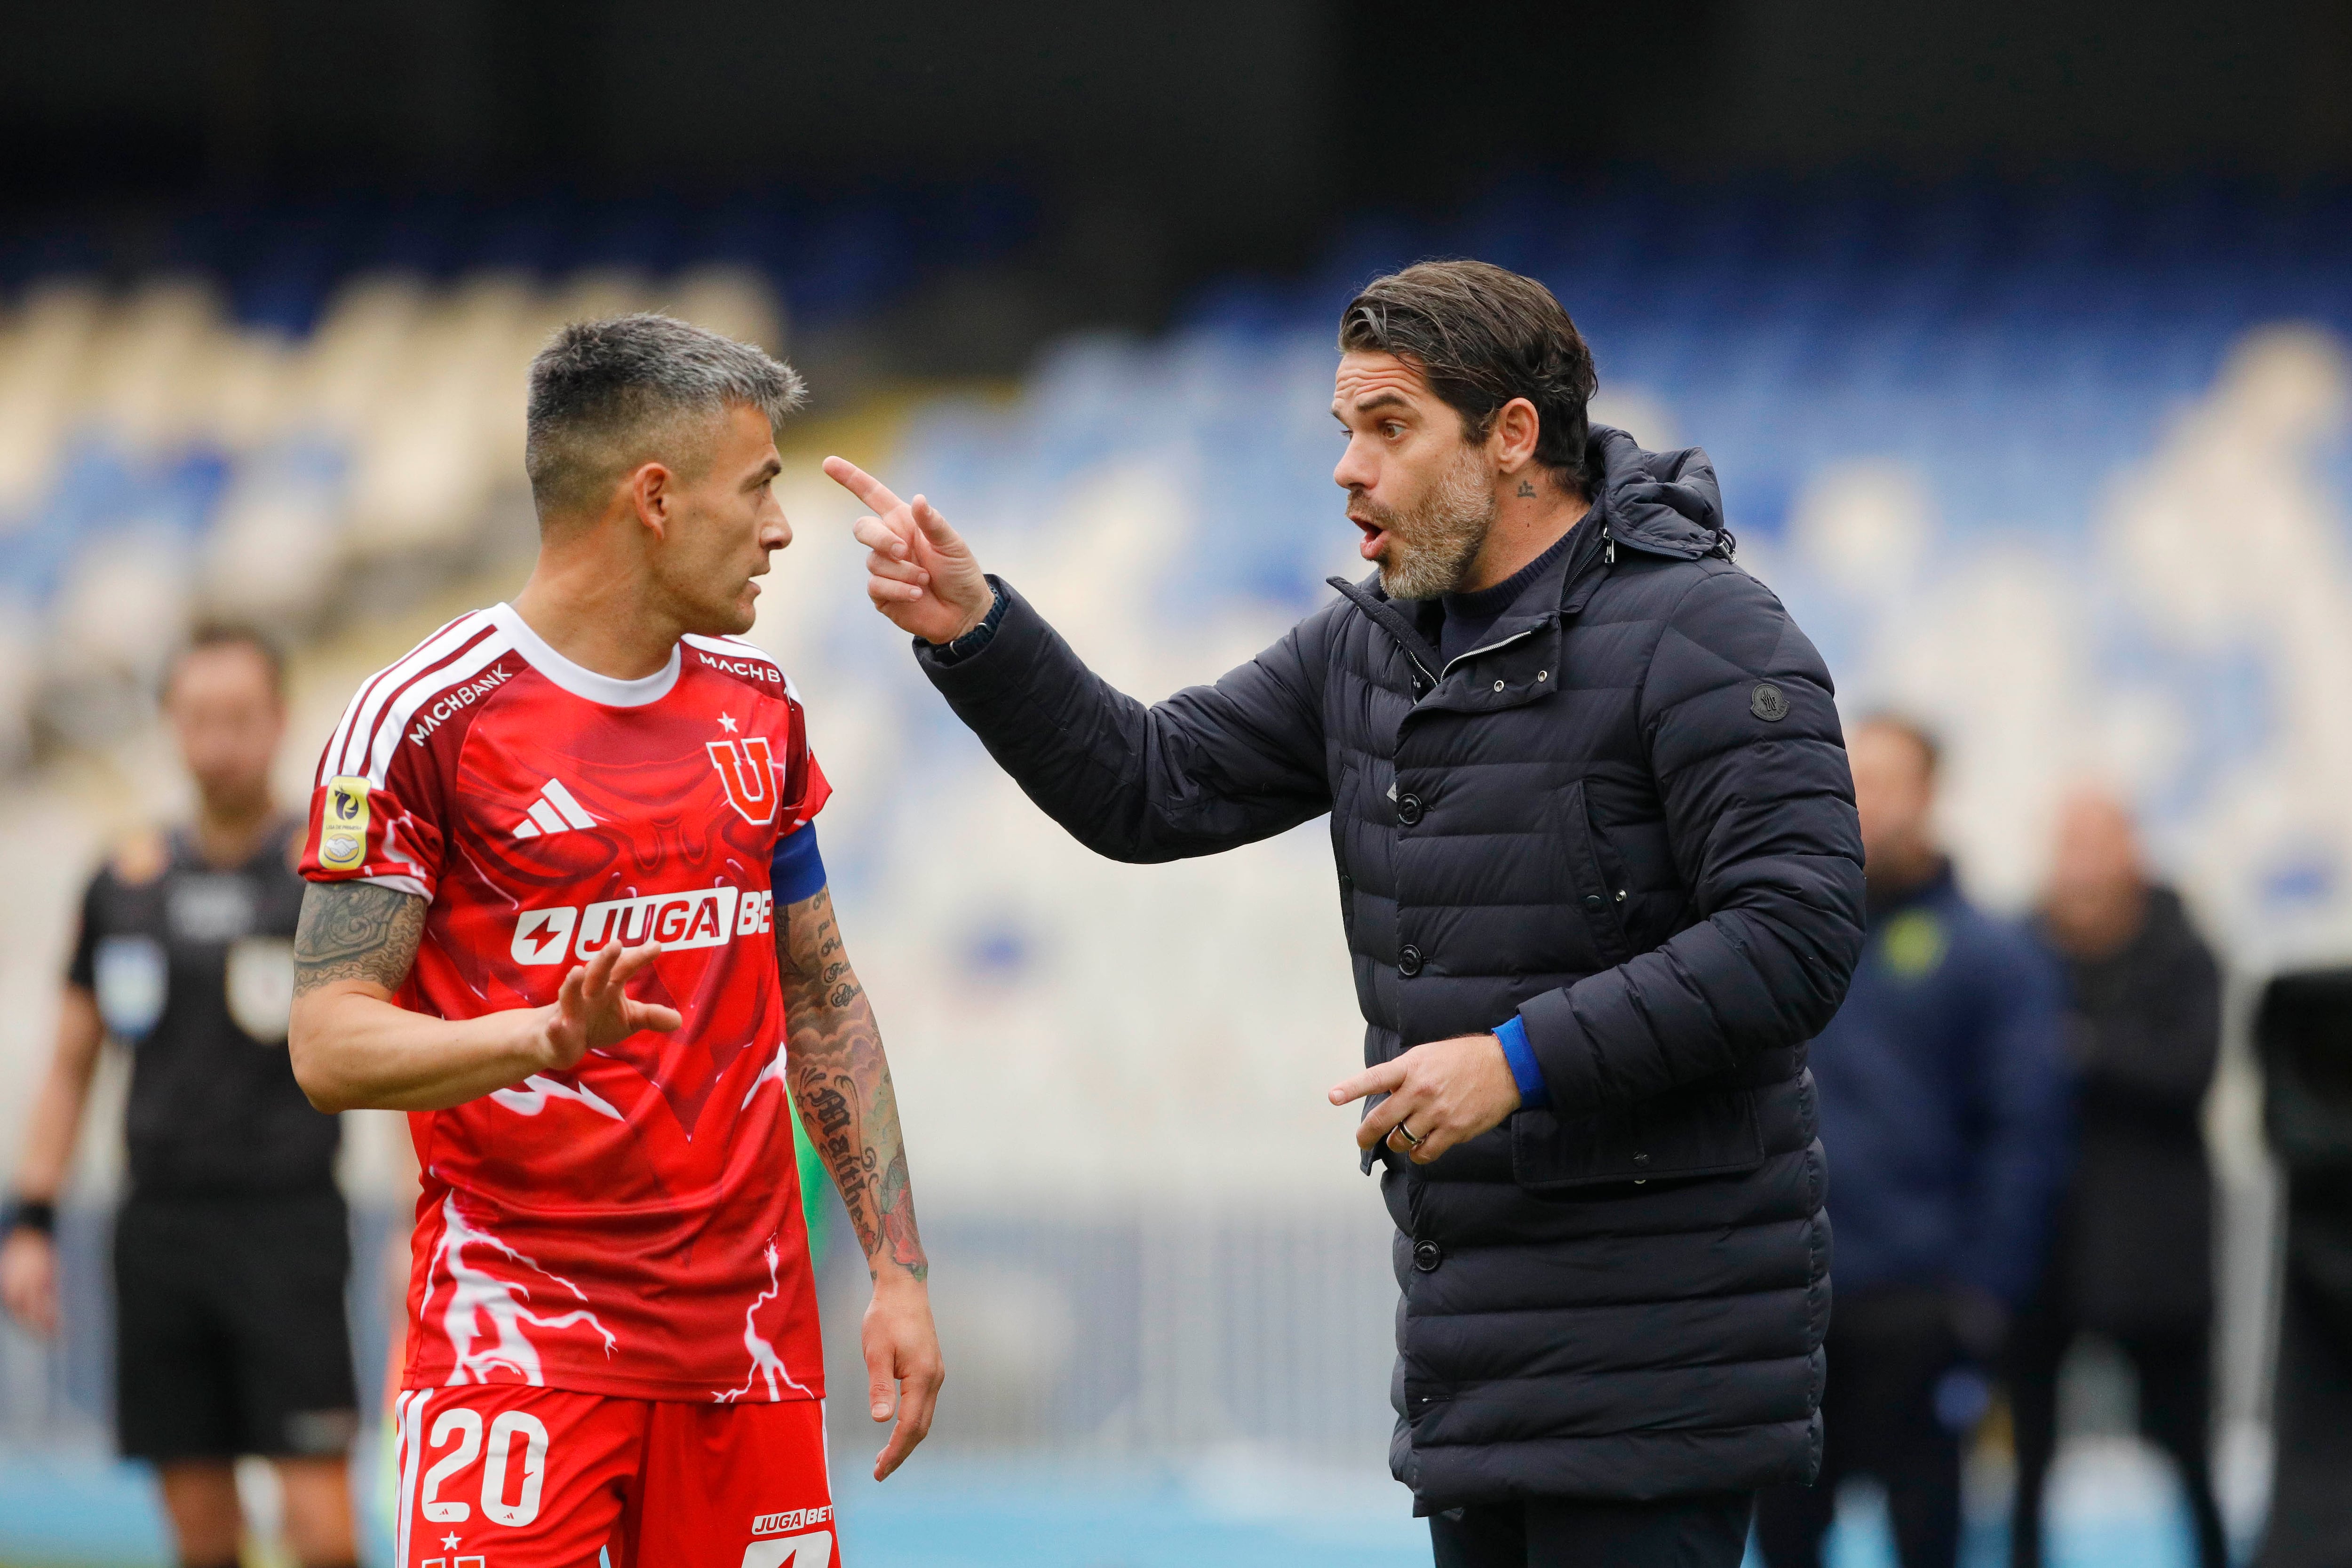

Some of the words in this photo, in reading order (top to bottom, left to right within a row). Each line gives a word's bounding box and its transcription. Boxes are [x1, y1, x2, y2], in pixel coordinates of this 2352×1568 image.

[409, 663, 513, 747] MACHBANK
[706, 737, 778, 826] U
[421, 1408, 549, 1527] 20
[755, 1504, 833, 1533] JUGABET
